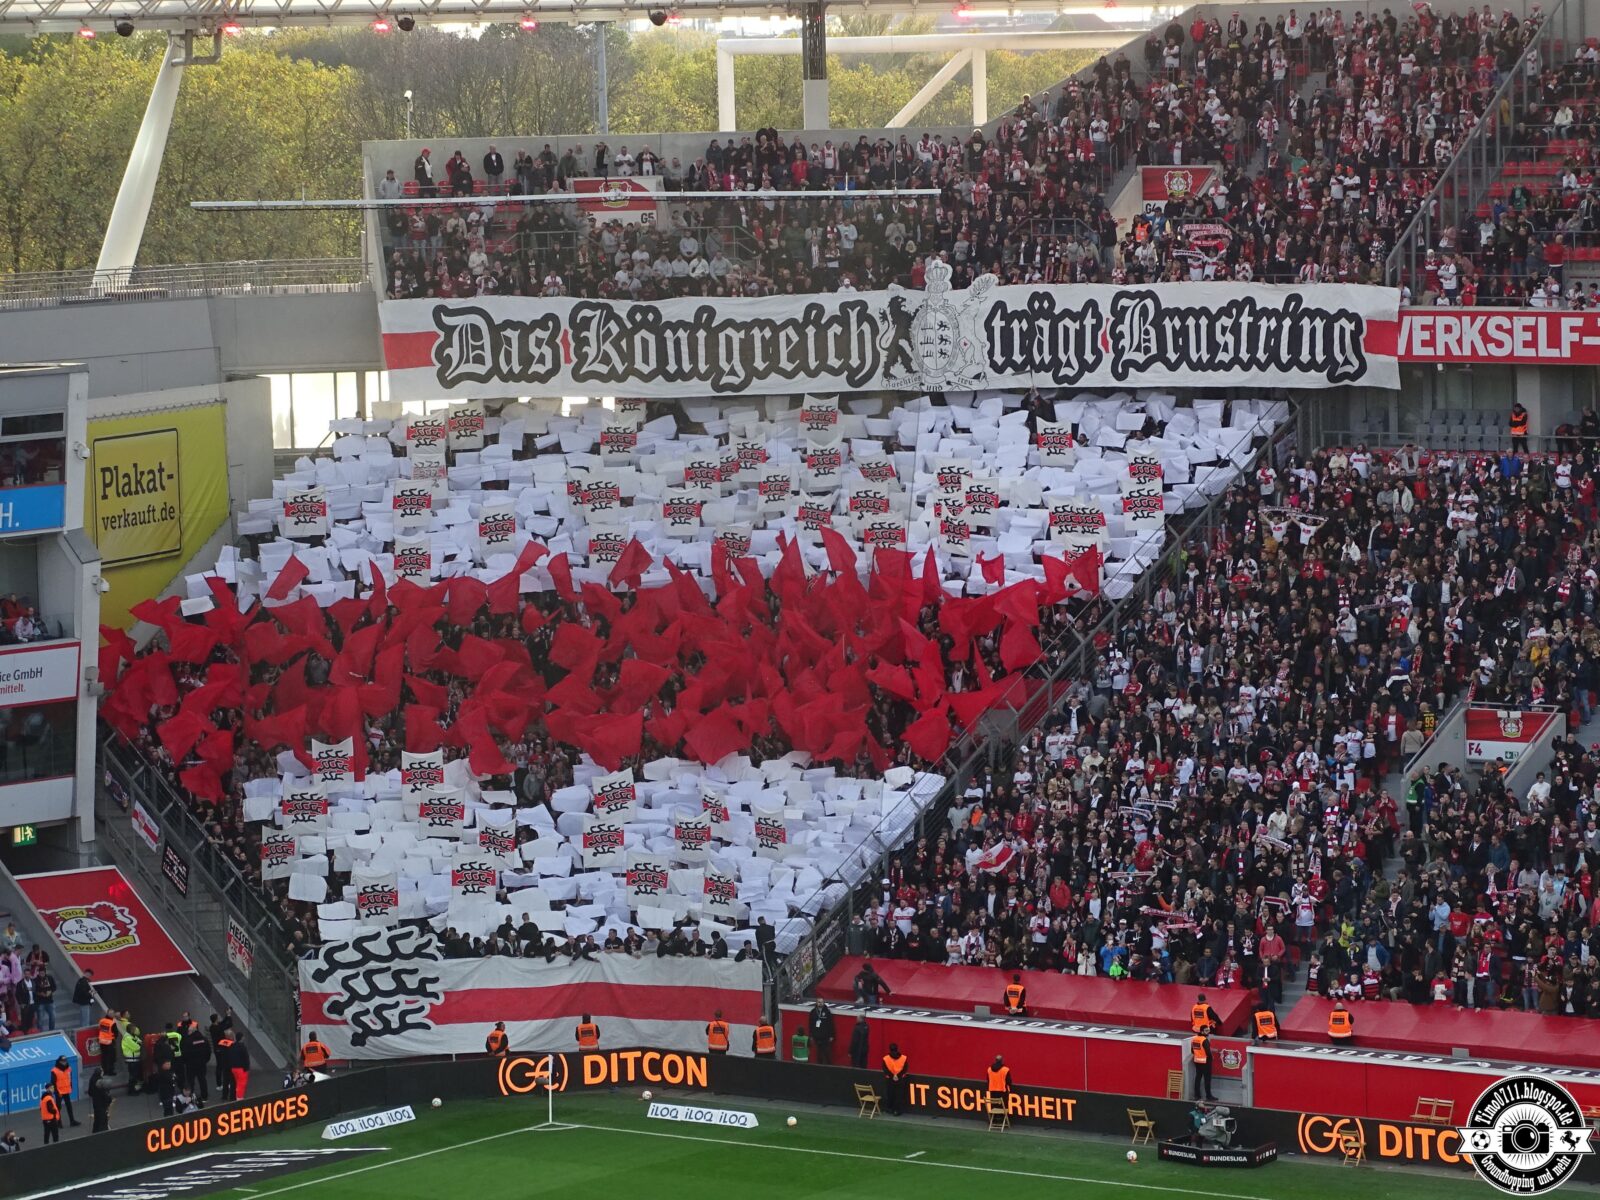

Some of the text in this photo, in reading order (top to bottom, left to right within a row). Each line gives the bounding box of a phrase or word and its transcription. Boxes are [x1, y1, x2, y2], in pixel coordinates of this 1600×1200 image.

[433, 290, 1366, 391] Das Königreich trägt Brustring
[100, 462, 174, 500] Plakat-
[102, 502, 176, 531] verkauft.de
[14, 667, 43, 680] GmbH
[1468, 742, 1483, 756] F4
[61, 909, 85, 919] 1904
[64, 937, 131, 951] Leverkusen
[229, 921, 254, 954] HESSEN
[1293, 1046, 1444, 1064] CASTORE
[583, 1051, 708, 1087] DITCON
[1506, 1064, 1600, 1079] TORE
[909, 1083, 1077, 1121] IT SICHRHEIT
[146, 1094, 309, 1153] CLOUD SERVICES
[1168, 1150, 1197, 1159] BUNDESLIGA
[1379, 1124, 1473, 1165] DITC
[1209, 1155, 1248, 1163] BUNDESLIGA
